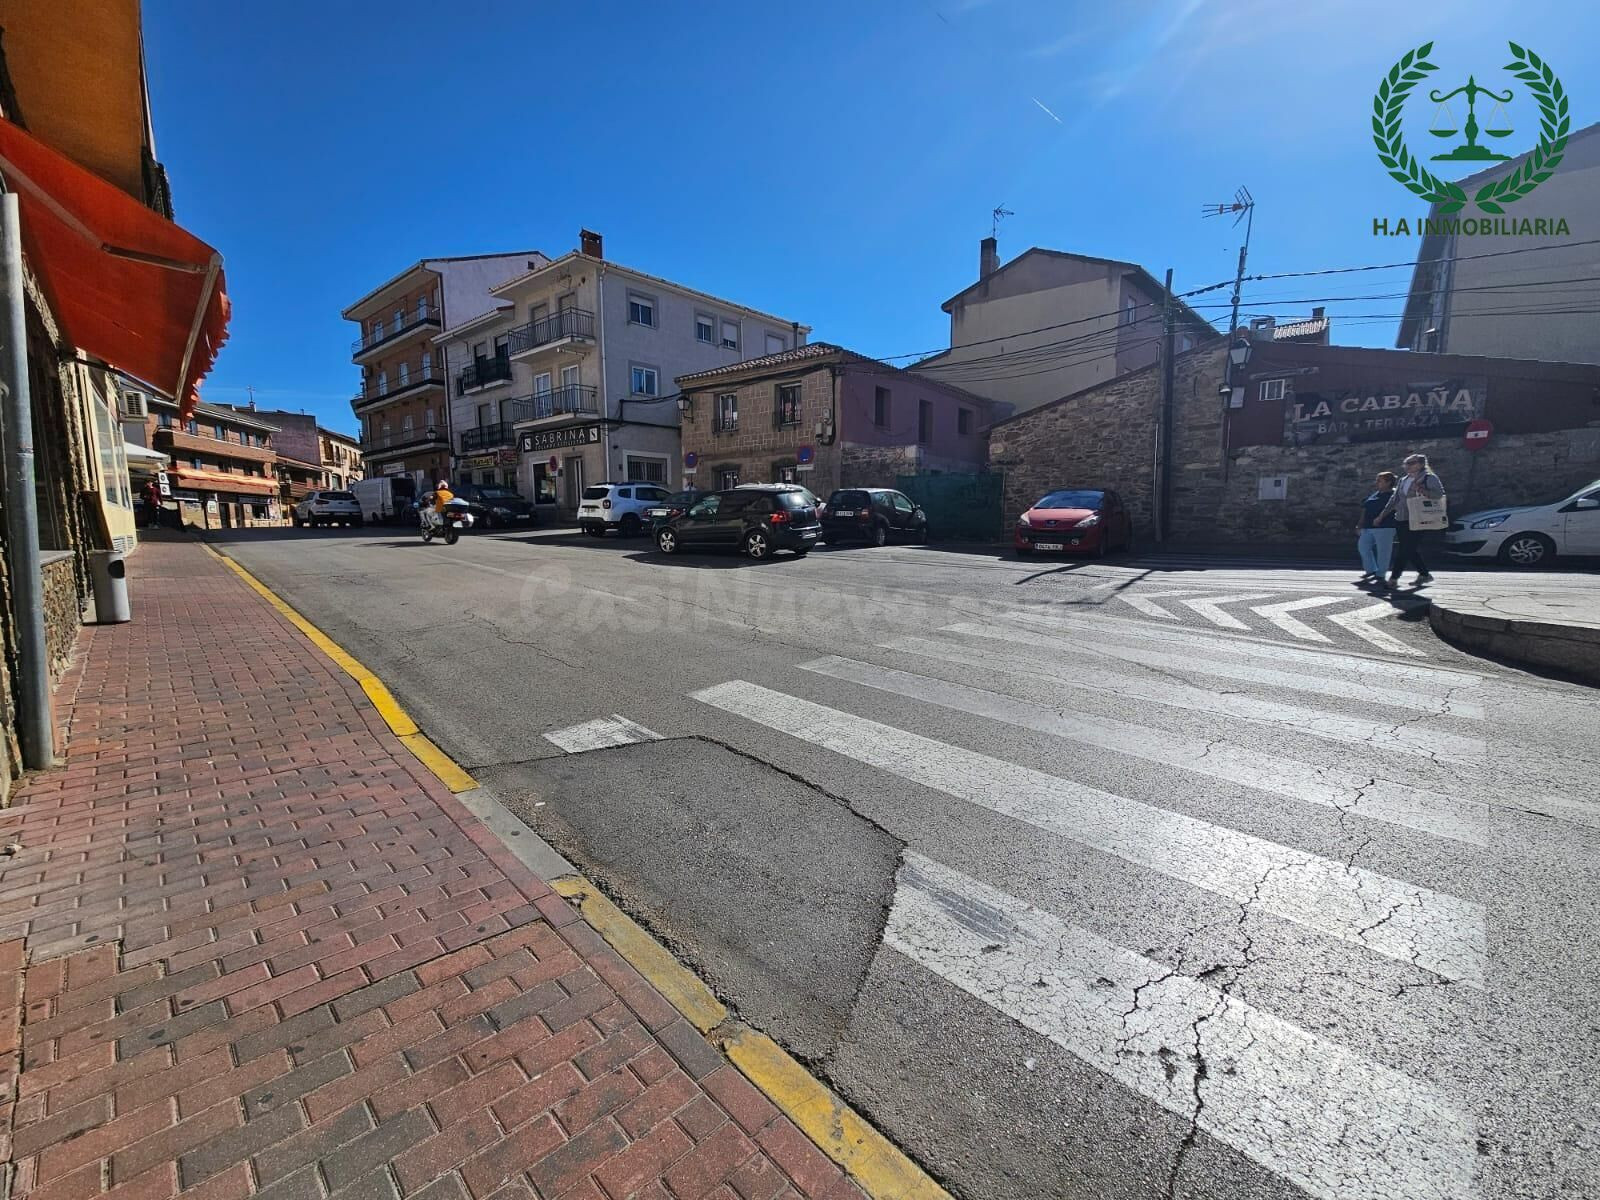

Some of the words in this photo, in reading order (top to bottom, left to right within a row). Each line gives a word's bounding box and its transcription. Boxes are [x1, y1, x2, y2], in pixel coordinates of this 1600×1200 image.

[1293, 401, 1332, 423] LA
[1340, 387, 1474, 413] CABAÑA
[1318, 421, 1348, 434] BAR
[1365, 415, 1440, 430] TERRAZA
[535, 429, 585, 446] SABRINA
